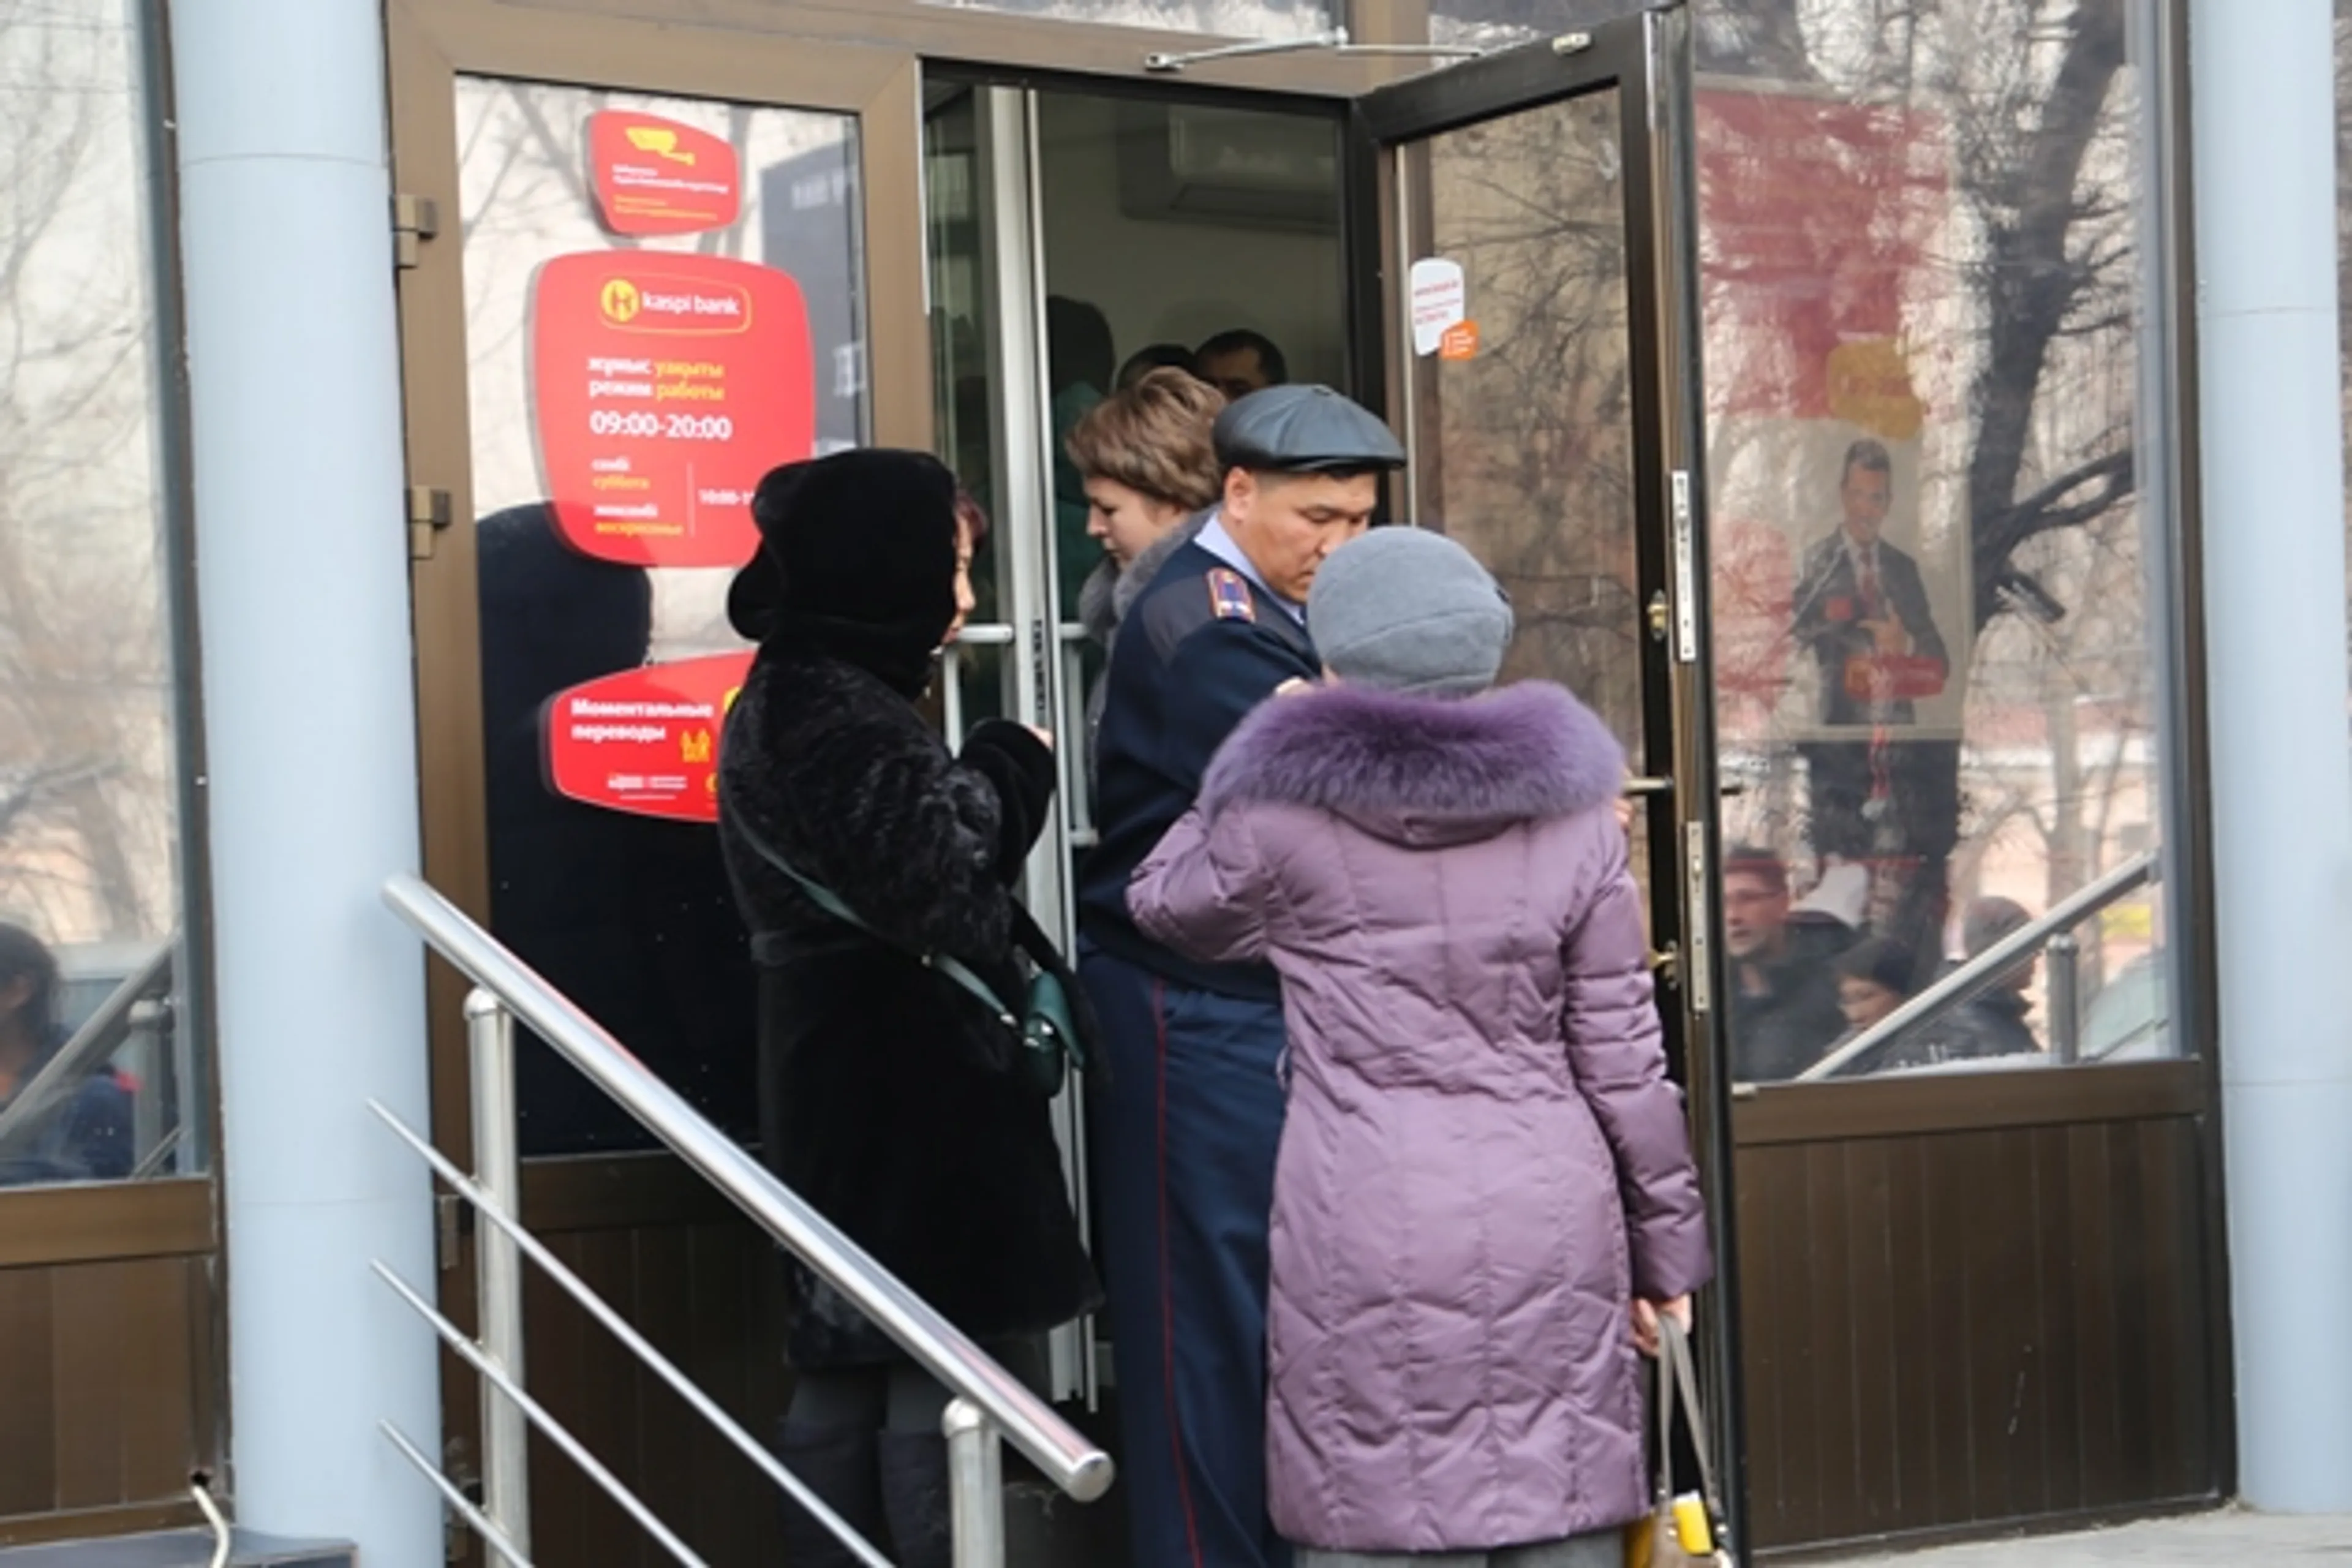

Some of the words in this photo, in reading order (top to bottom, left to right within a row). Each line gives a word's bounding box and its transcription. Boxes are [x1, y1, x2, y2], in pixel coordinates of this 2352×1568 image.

[643, 292, 691, 314] kaspi
[695, 295, 740, 315] bank
[589, 380, 652, 398] режим
[657, 379, 725, 401] работы
[590, 409, 733, 440] 09:00-20:00
[593, 475, 649, 490] суббота
[571, 698, 713, 718] Моментальные
[571, 723, 666, 743] переводы
